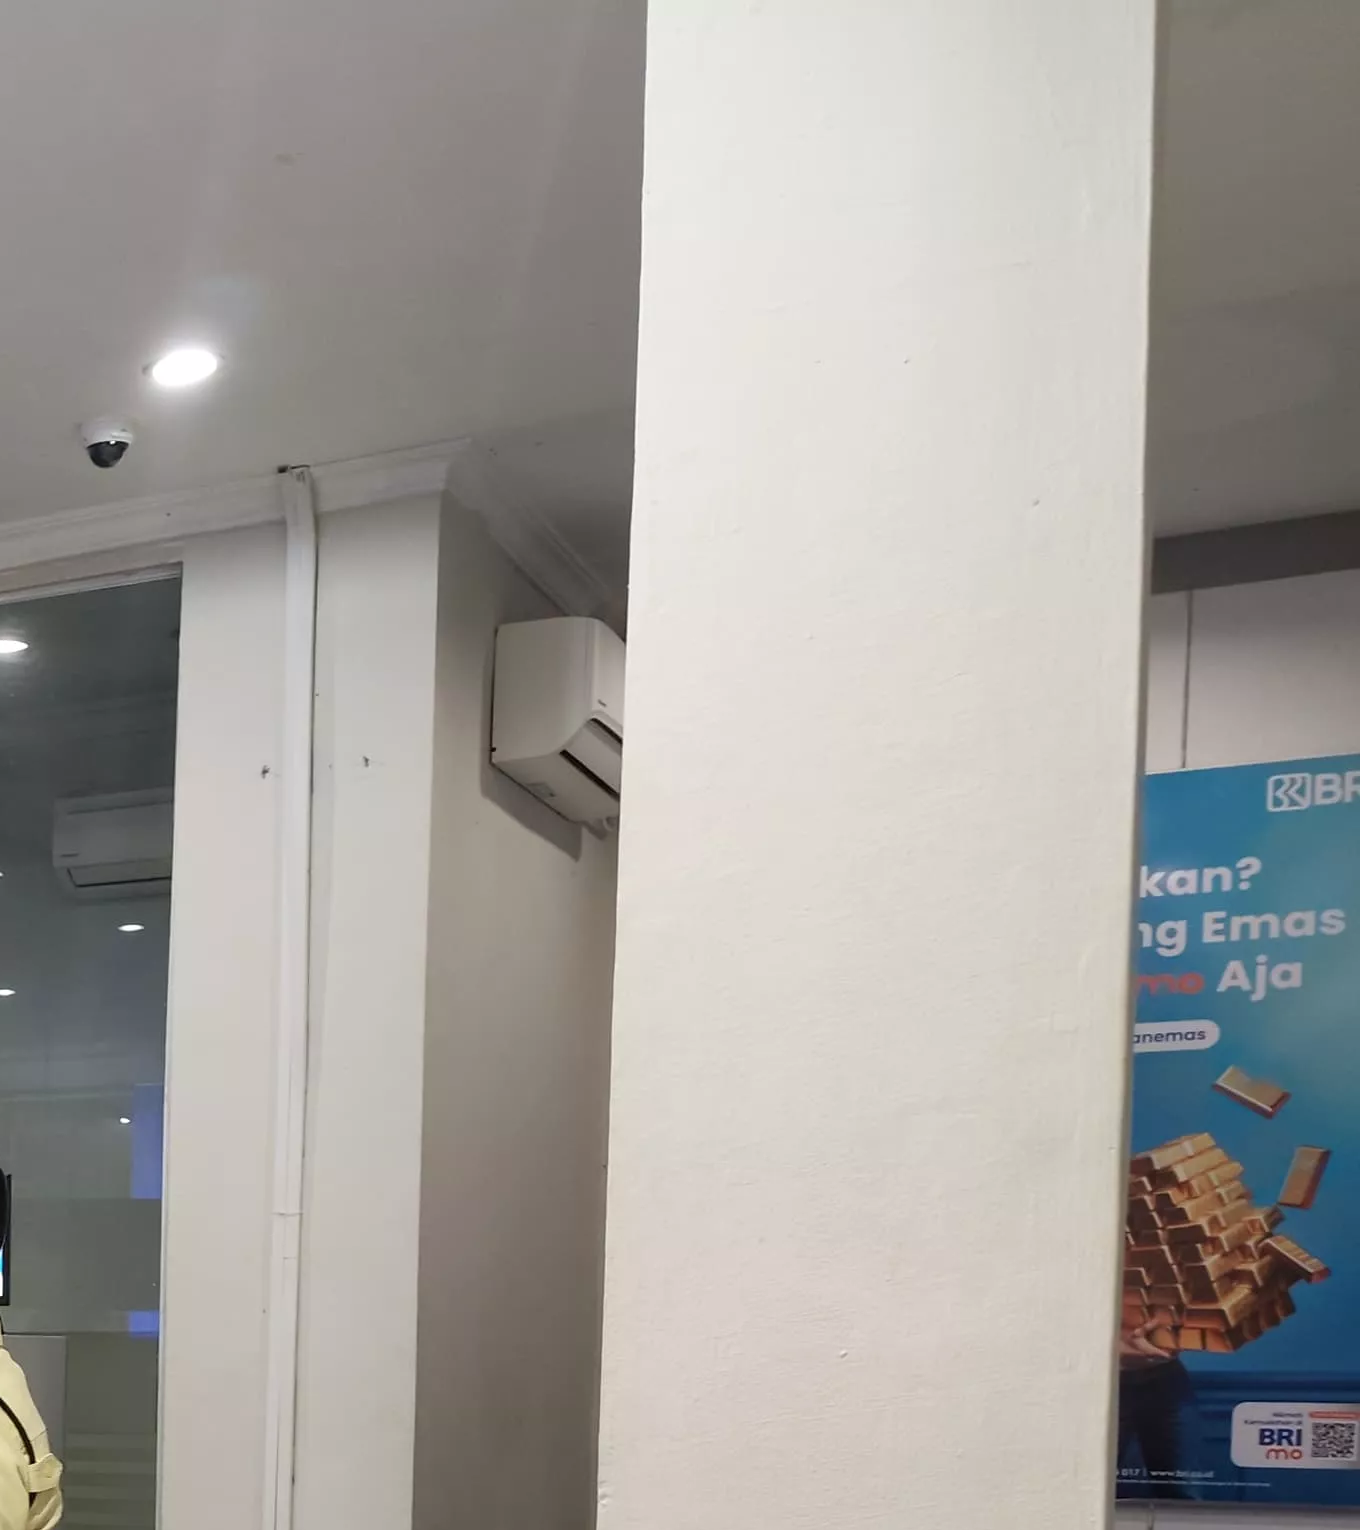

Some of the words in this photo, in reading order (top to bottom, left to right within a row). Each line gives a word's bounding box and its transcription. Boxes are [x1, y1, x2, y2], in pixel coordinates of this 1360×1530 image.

[1315, 771, 1360, 805] BR
[1139, 856, 1262, 897] kan?
[1137, 919, 1188, 957] ng
[1202, 907, 1346, 944] Emas
[1135, 971, 1205, 997] mo
[1217, 954, 1303, 1002] Aja
[1133, 1030, 1206, 1044] anemas
[1259, 1428, 1303, 1446] BRI
[1265, 1448, 1303, 1460] mo
